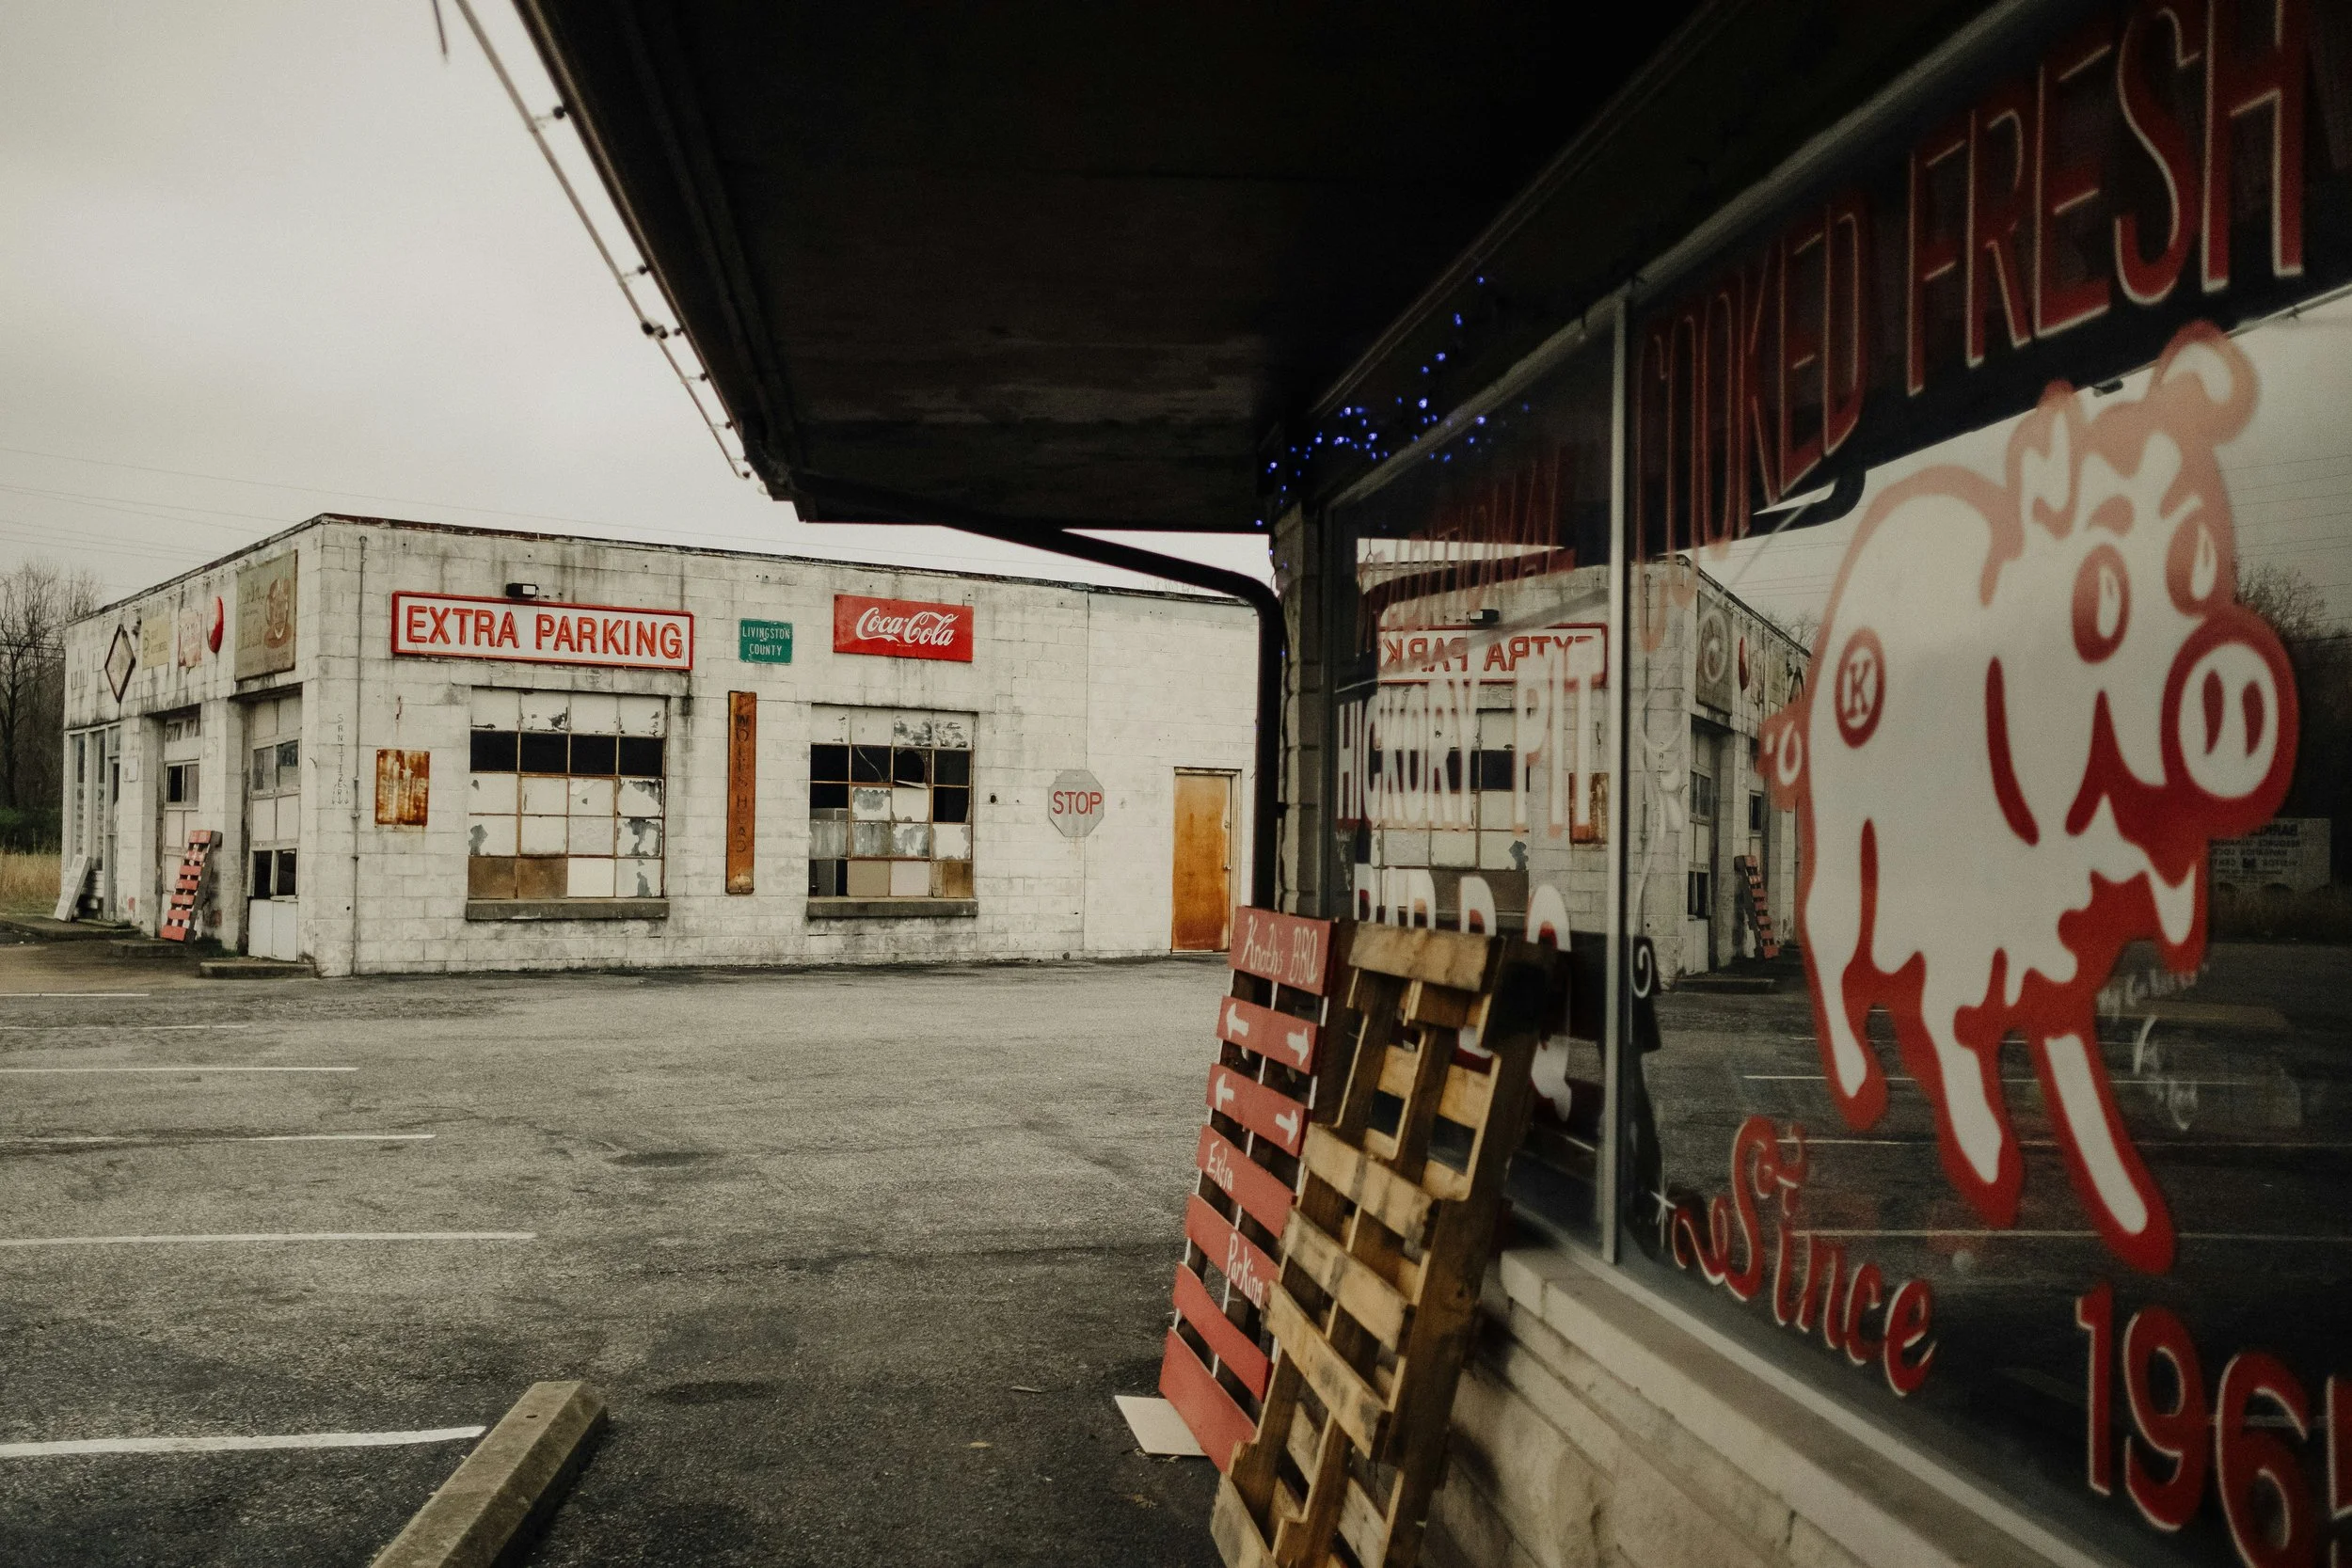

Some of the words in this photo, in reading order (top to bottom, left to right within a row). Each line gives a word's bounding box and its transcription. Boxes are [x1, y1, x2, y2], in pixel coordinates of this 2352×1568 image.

[1906, 0, 2305, 396] FRESH
[406, 605, 519, 648] EXTRA
[535, 614, 682, 658] PARKING
[742, 626, 790, 640] LIVINGSTON
[749, 643, 783, 656] COUNTY
[856, 607, 960, 646] Coca-Cola
[1845, 658, 1872, 719] K
[337, 714, 345, 796] SANITIZER
[1337, 672, 1480, 825] HICKORY
[1514, 640, 1604, 828] PIT
[1053, 791, 1103, 815] STOP
[1289, 926, 1318, 984] BBQ
[1207, 1140, 1233, 1192] Extra
[1673, 1116, 1938, 1397] Since
